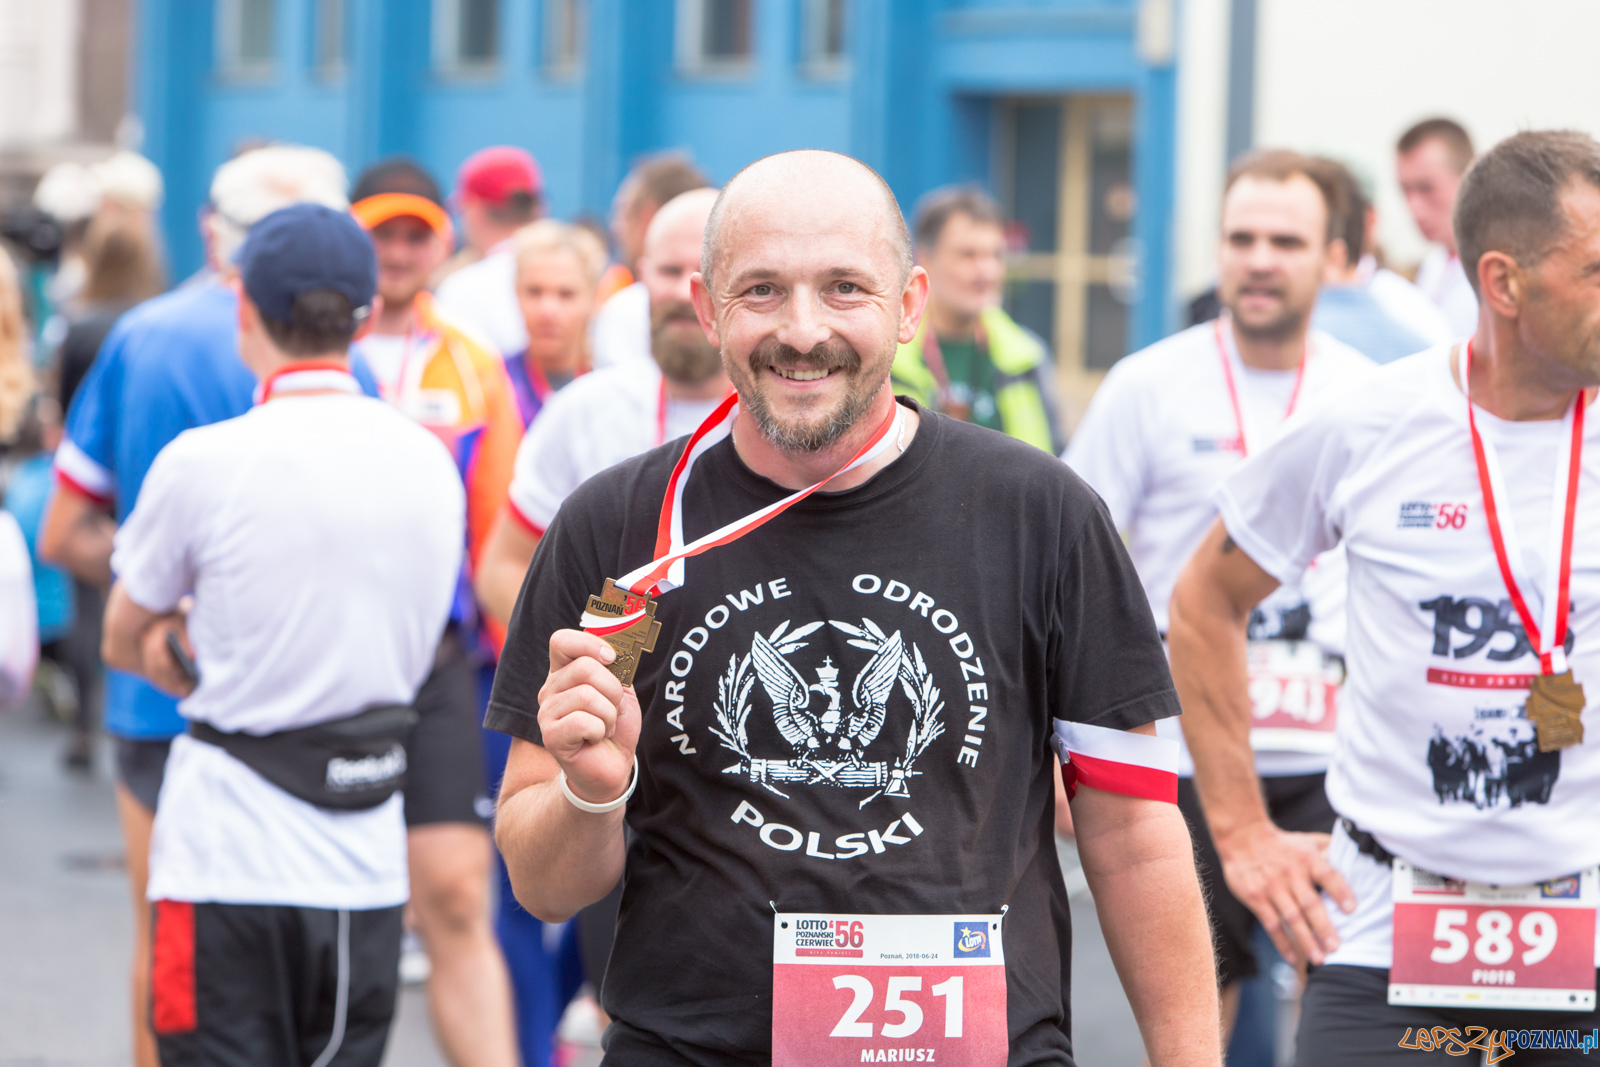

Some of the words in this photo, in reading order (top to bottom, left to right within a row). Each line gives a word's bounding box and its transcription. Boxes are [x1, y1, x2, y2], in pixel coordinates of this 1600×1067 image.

[590, 599, 624, 616] POZNAŃ
[1419, 595, 1575, 661] 195
[664, 577, 792, 755] NARODOWE
[852, 574, 988, 768] ODRODZENIE
[730, 799, 924, 859] POLSKI
[796, 919, 828, 930] LOTTO
[795, 930, 834, 938] POZNAŃSKI
[795, 938, 834, 947] CZERWIEC
[964, 935, 982, 948] LOTTO
[1430, 908, 1558, 966] 589
[1472, 969, 1516, 985] PIOTR
[829, 974, 964, 1038] 251
[860, 1048, 935, 1063] MARIUSZ
